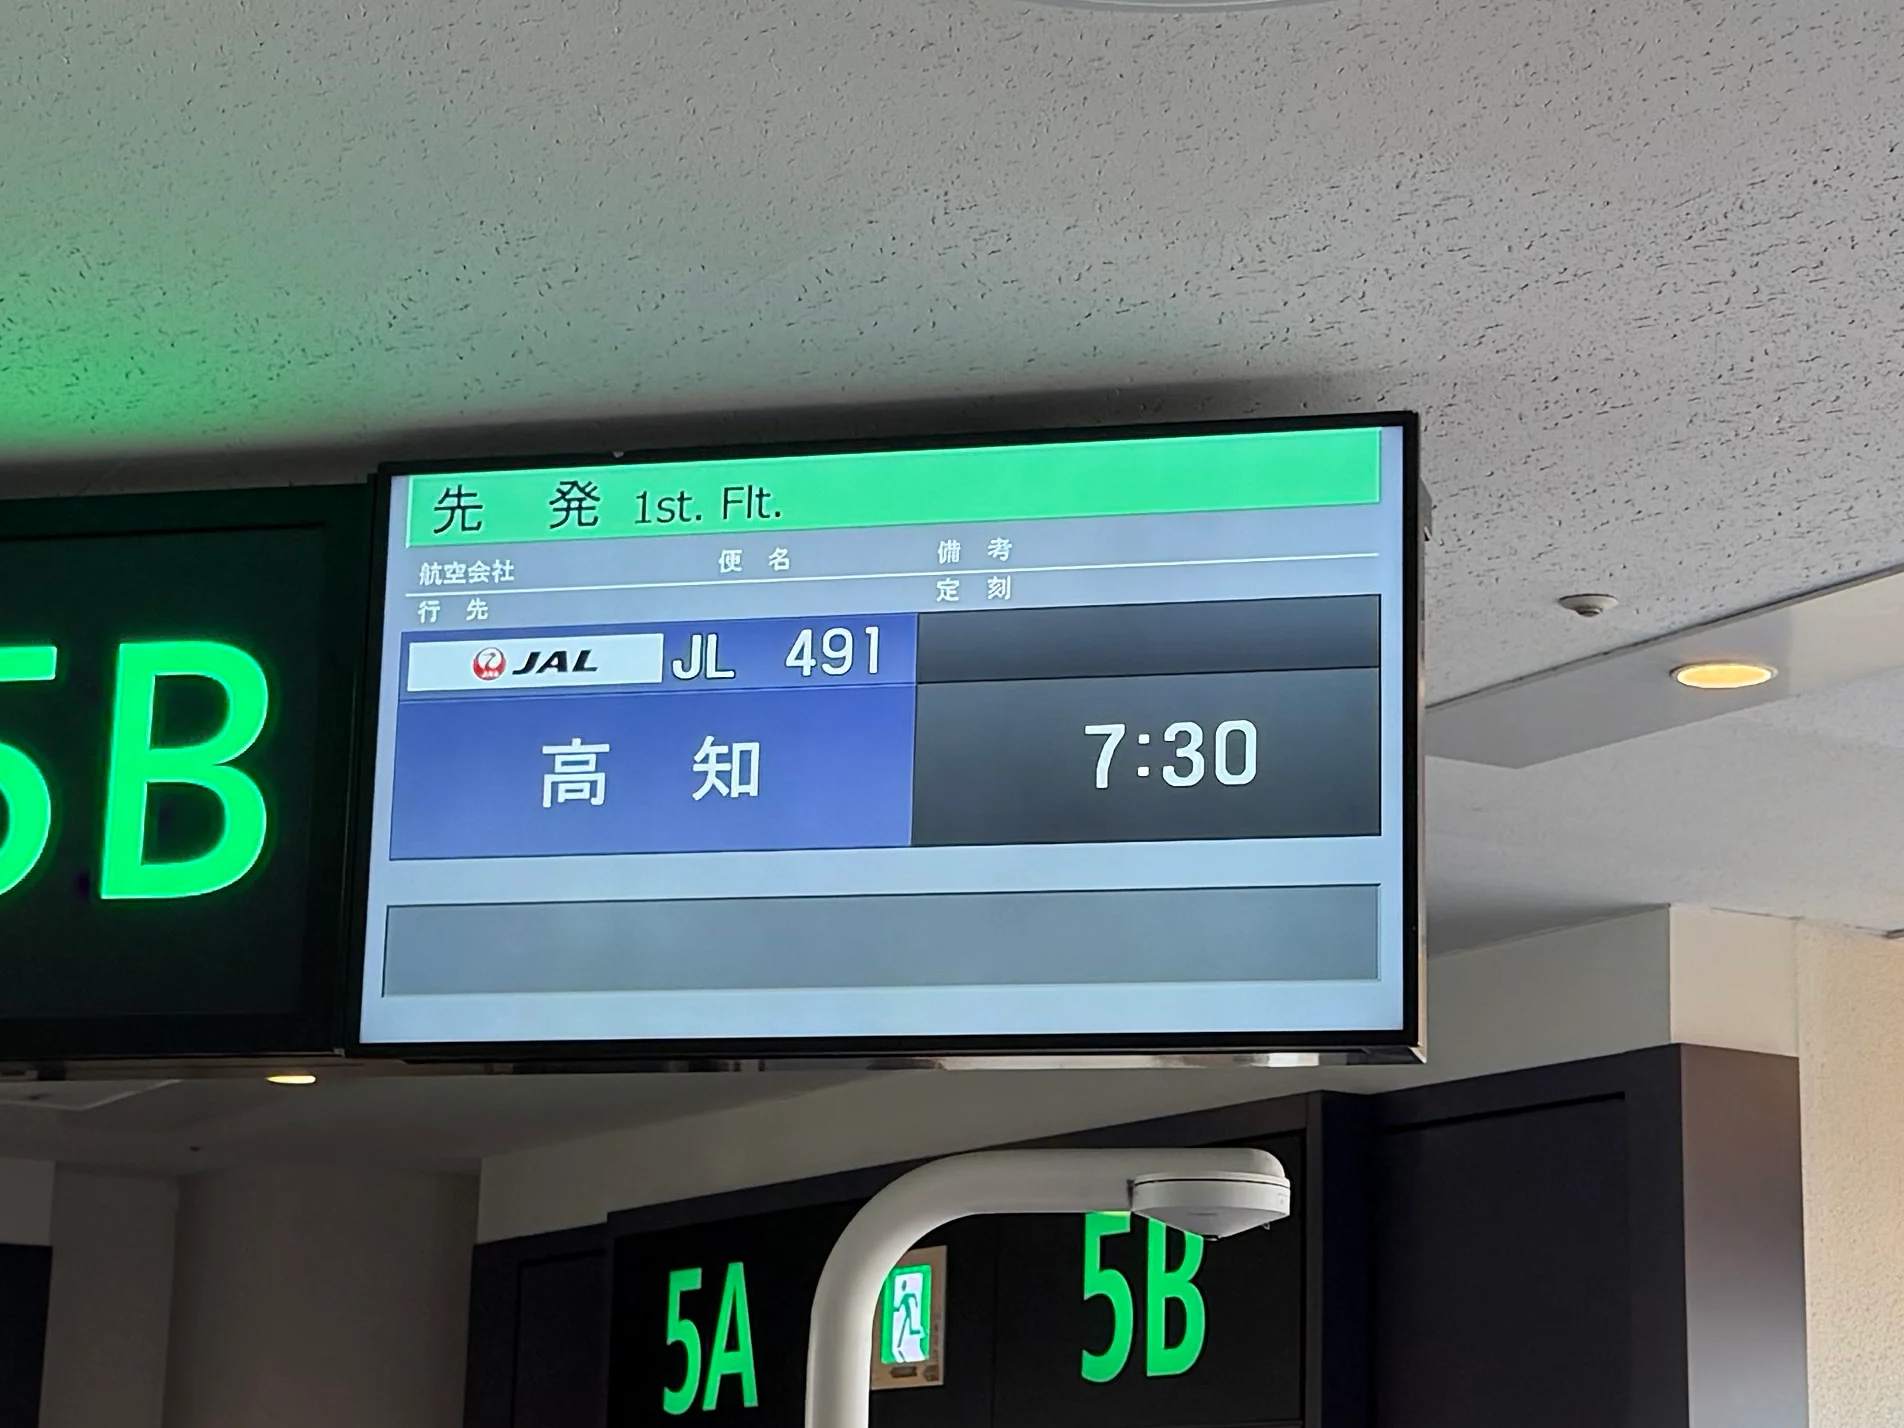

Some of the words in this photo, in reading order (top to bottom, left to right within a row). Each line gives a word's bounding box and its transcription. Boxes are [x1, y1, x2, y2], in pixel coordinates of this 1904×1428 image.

[635, 490, 702, 525] 1st.
[723, 485, 783, 519] Flt.
[419, 559, 514, 586] 航空会社
[512, 649, 598, 675] JAL
[672, 633, 736, 680] JL
[785, 627, 880, 677] 491
[1083, 720, 1258, 791] 7:30
[1081, 1211, 1206, 1383] 5B
[662, 1261, 758, 1415] 5A
